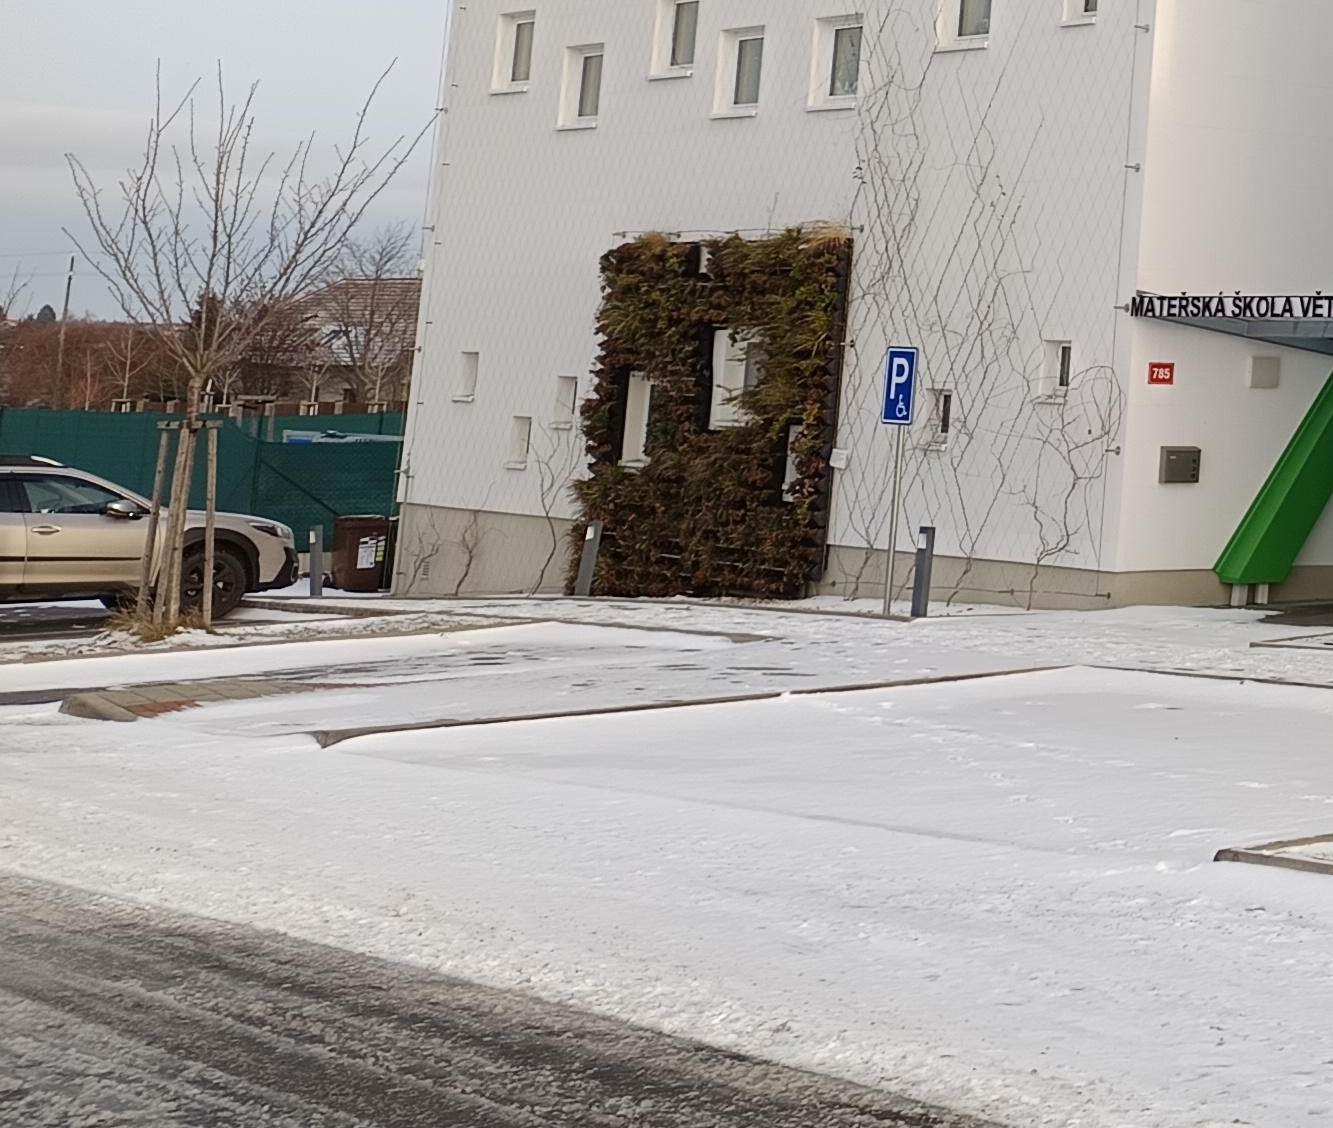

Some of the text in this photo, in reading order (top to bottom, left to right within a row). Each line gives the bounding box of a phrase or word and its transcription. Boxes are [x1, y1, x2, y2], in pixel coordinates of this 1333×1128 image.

[1130, 291, 1226, 318] MATEŘSKÁ
[1231, 290, 1295, 318] ŠKOLA
[889, 357, 910, 400] P
[1151, 367, 1171, 379] 785
